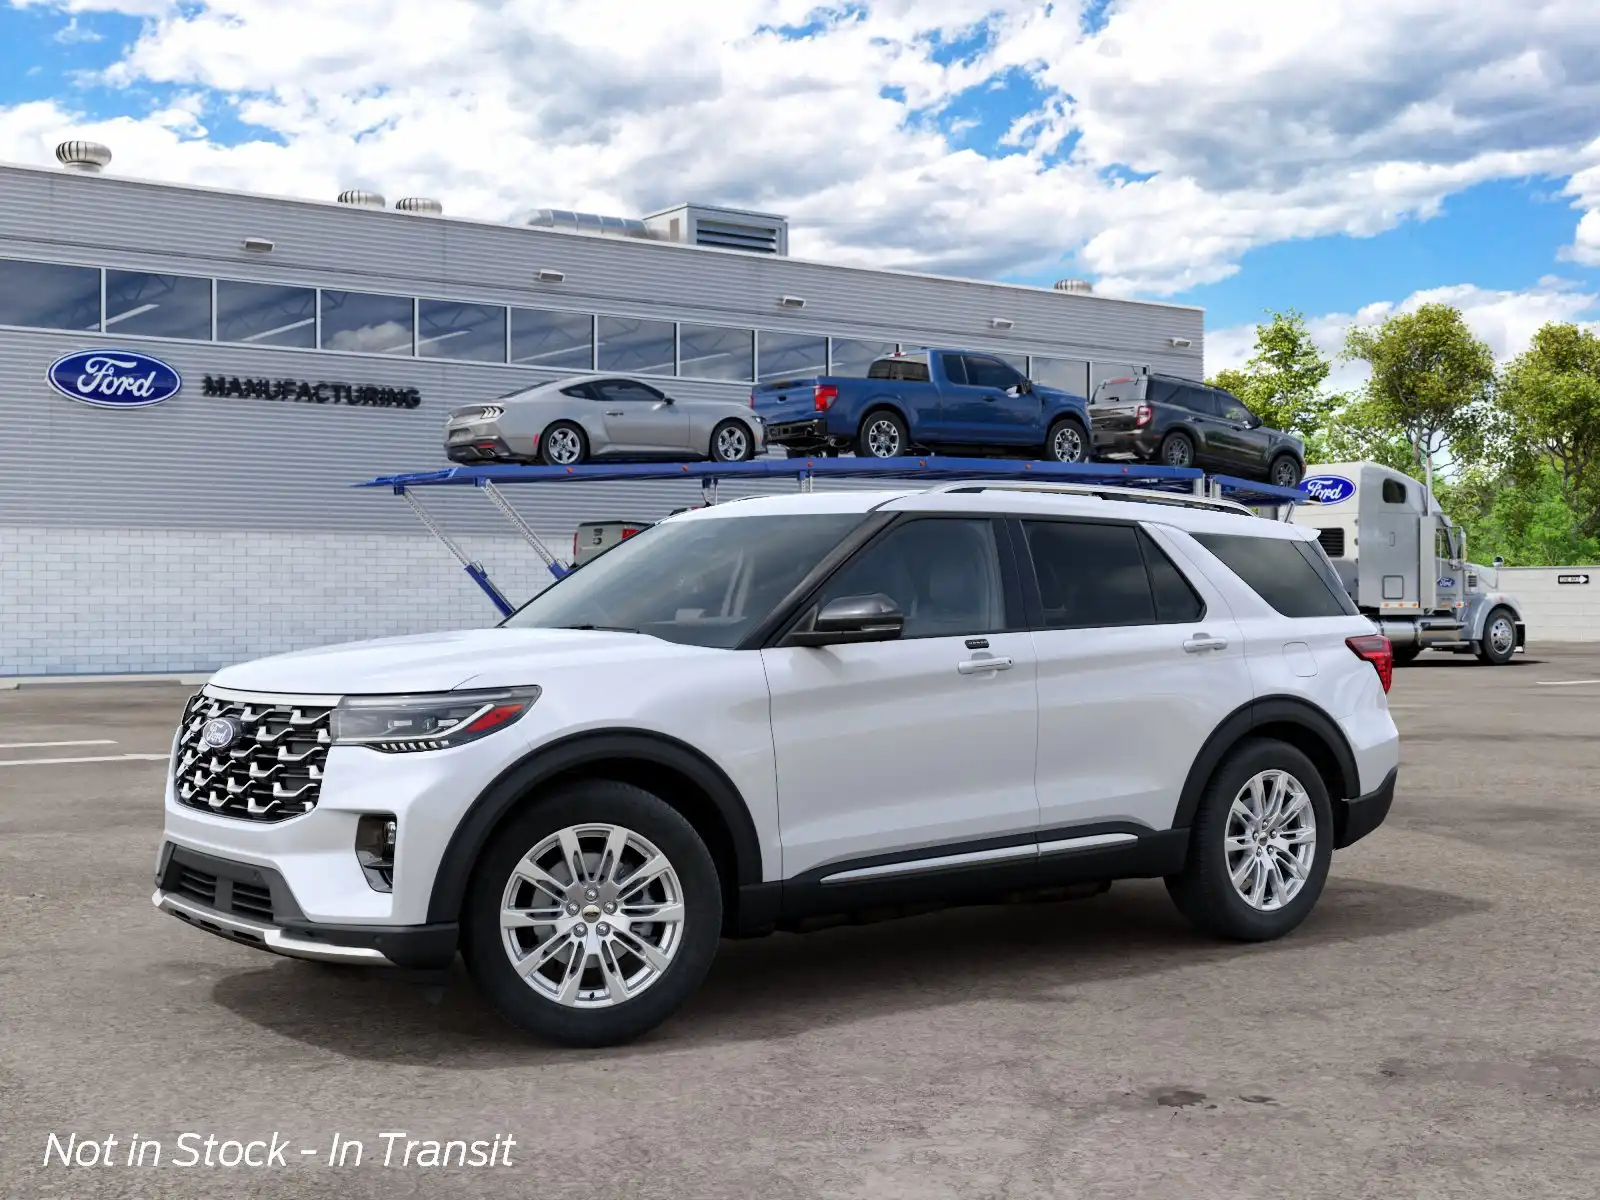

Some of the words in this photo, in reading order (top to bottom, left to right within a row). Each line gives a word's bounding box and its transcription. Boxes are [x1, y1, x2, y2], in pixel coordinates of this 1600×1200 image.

[77, 357, 157, 397] Ford
[202, 373, 421, 409] MANUFACTURING
[1306, 480, 1344, 500] Ford
[206, 722, 228, 744] Ford
